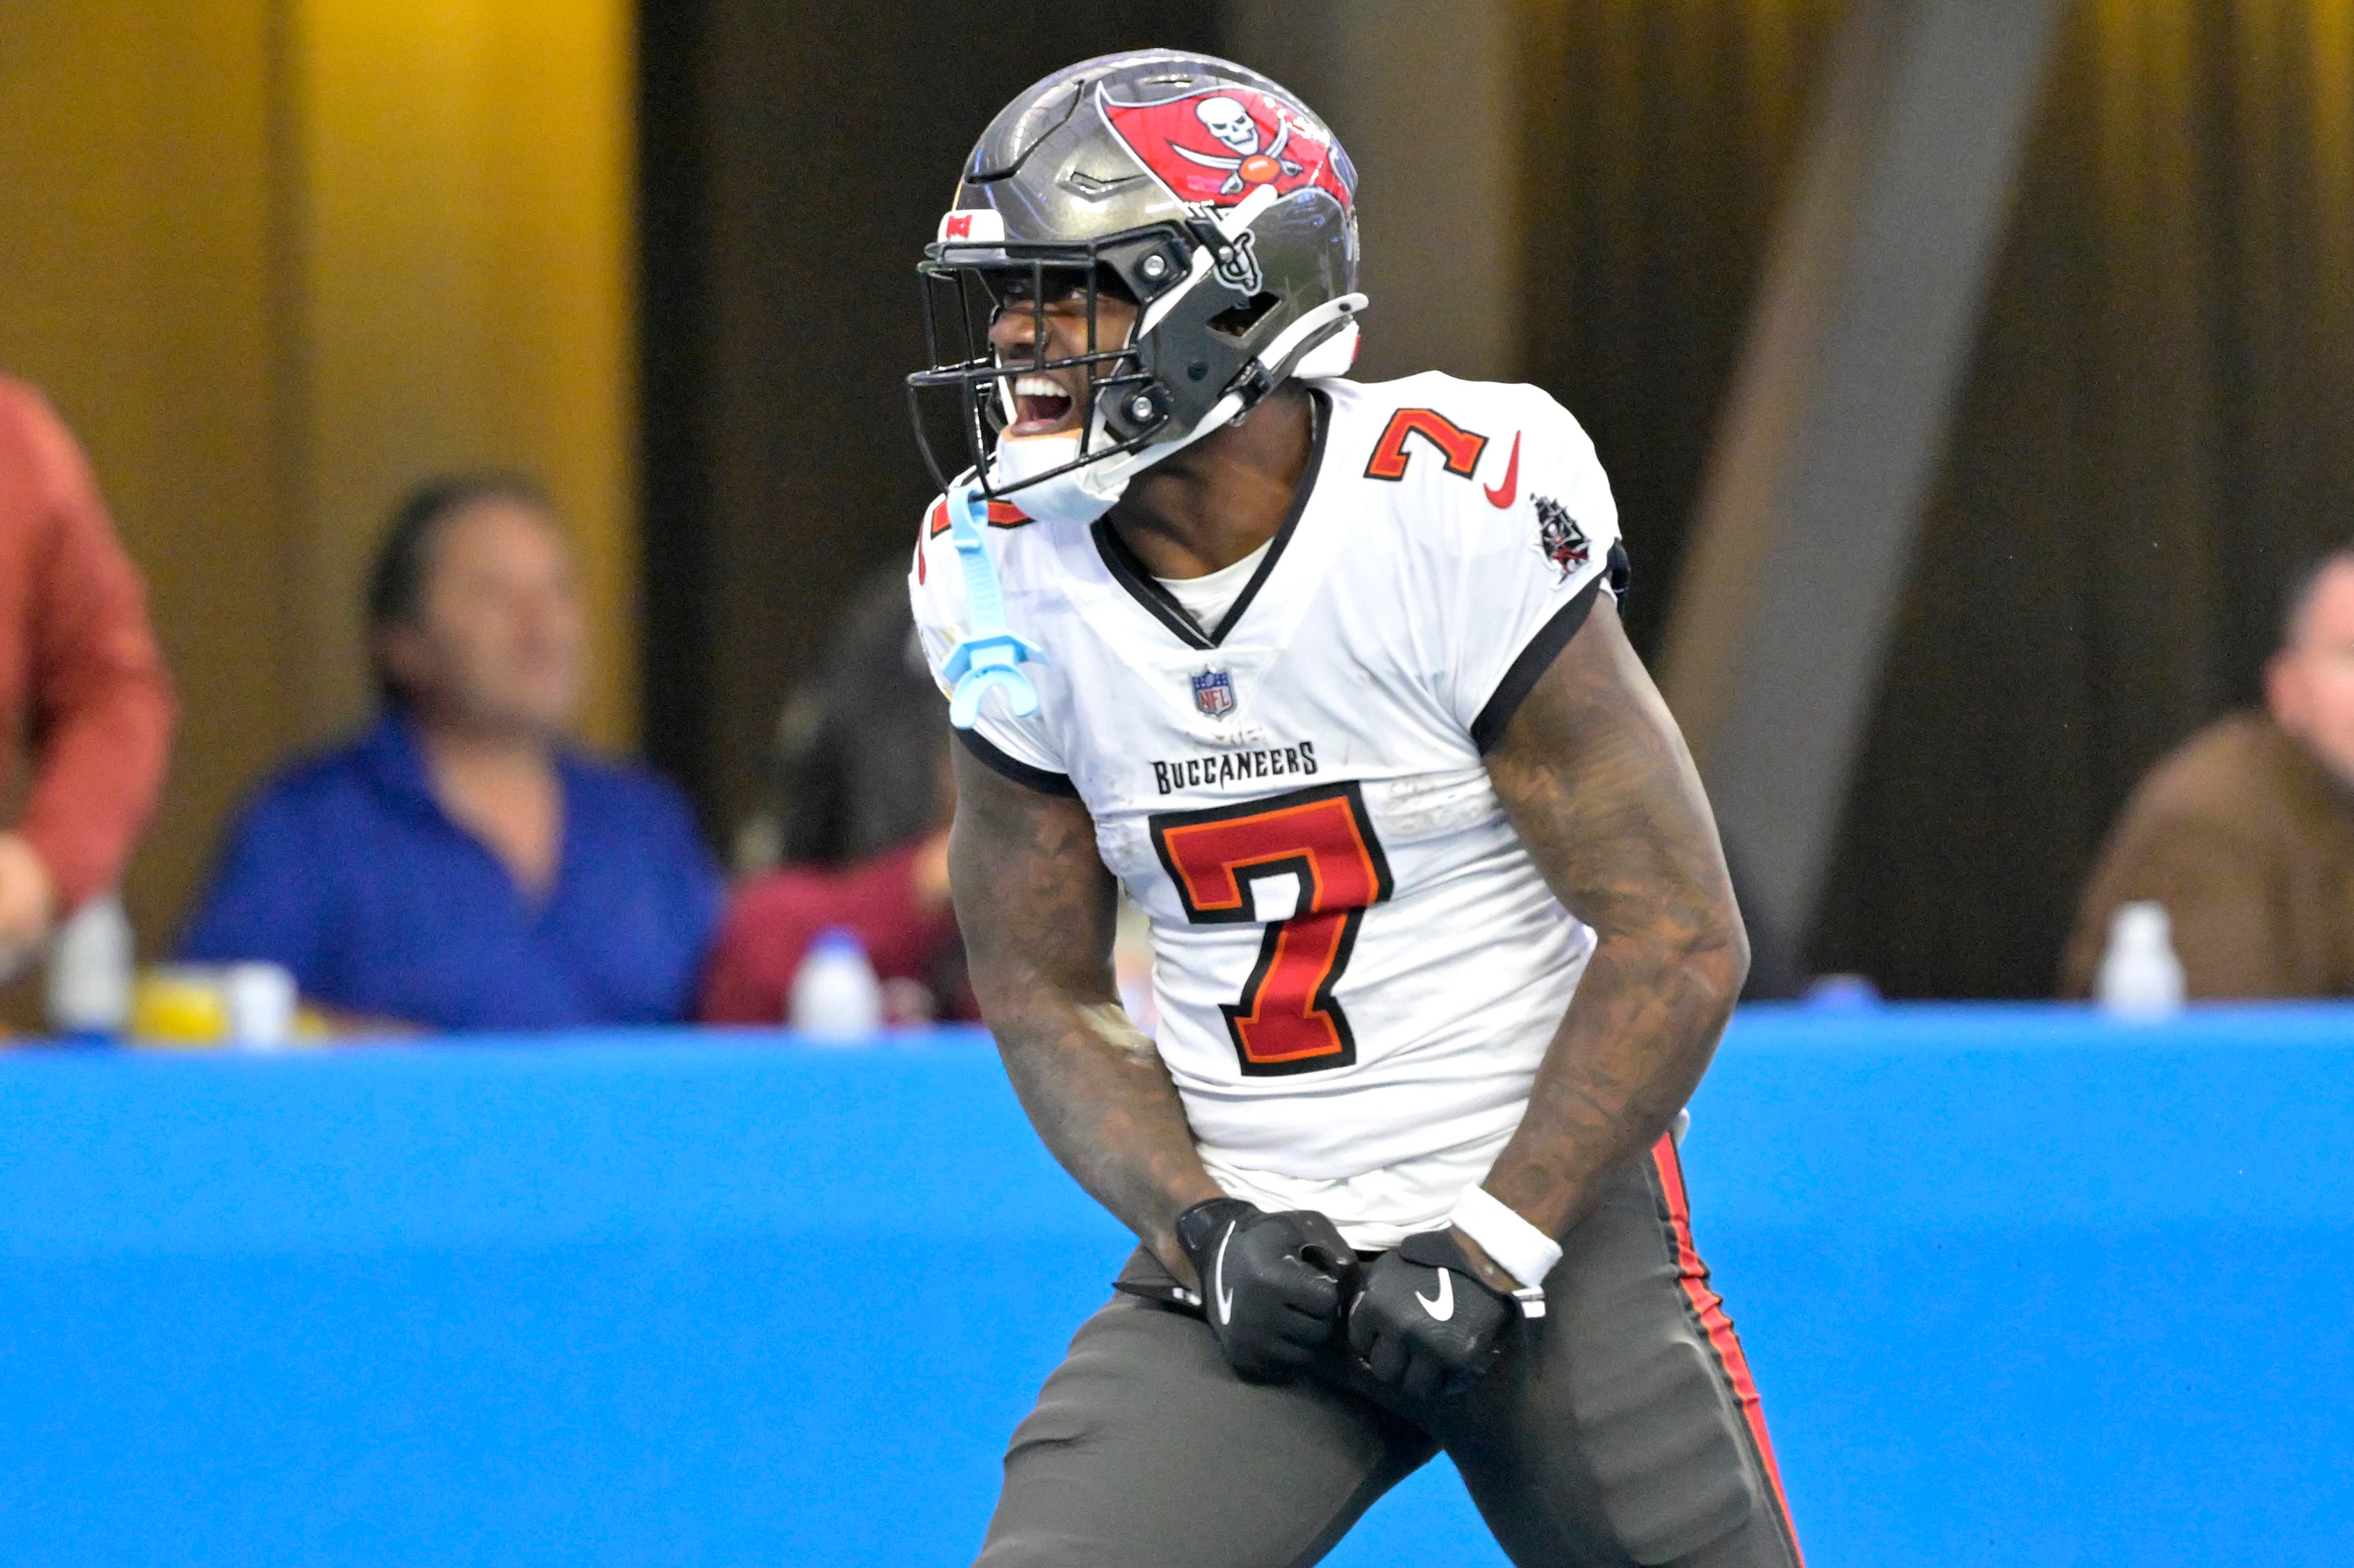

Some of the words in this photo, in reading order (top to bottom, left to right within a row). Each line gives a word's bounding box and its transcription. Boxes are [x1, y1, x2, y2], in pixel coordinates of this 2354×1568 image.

[1363, 408, 1490, 481] 7
[1199, 688, 1230, 711] NFL
[1151, 741, 1318, 795] BUCCANEERS
[1148, 780, 1395, 1077] 7
